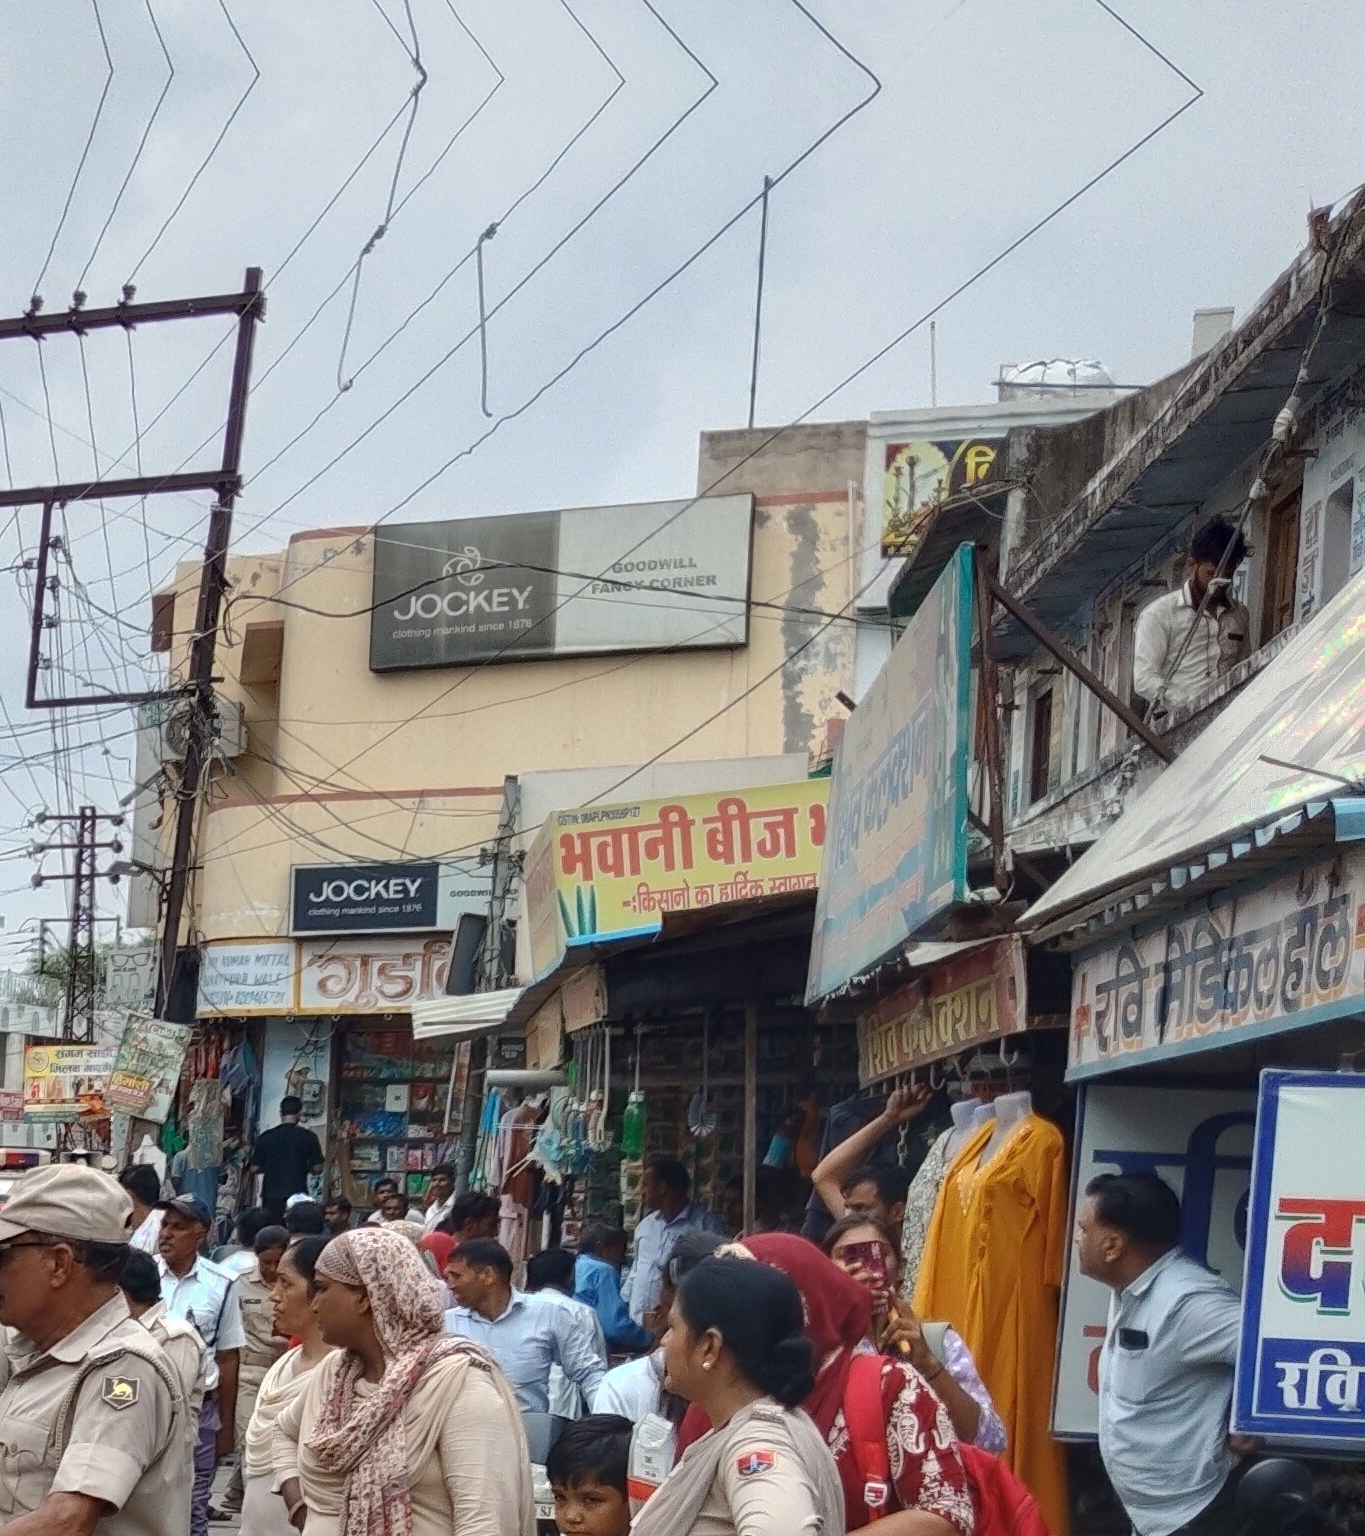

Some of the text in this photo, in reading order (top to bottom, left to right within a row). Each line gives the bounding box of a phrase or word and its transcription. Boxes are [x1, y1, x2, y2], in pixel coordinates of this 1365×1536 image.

[611, 556, 698, 574] GOODWILL
[648, 574, 717, 591] CORNER
[393, 586, 533, 620] JOCKEY
[392, 626, 431, 640] clothing
[432, 622, 476, 637] mankind
[478, 620, 505, 633] since
[559, 803, 696, 881] भवानी
[702, 797, 799, 866] बीज
[309, 877, 422, 903] JOCKEY
[308, 907, 341, 917] clothing
[341, 905, 376, 916] mankind
[378, 904, 400, 914] since
